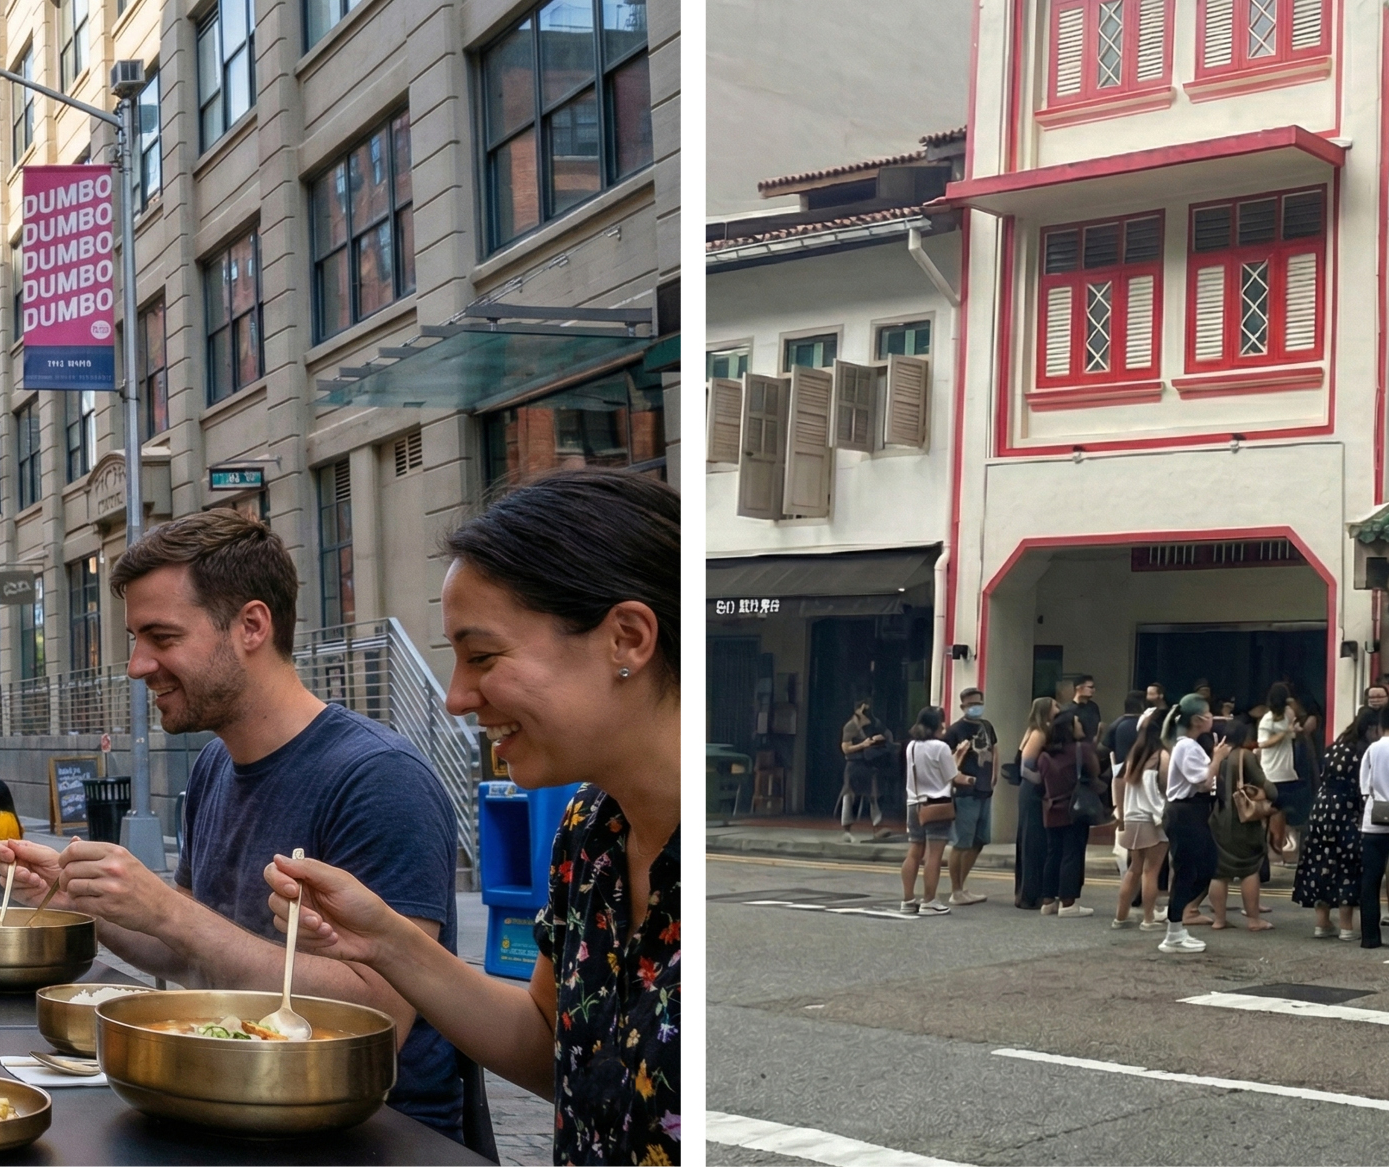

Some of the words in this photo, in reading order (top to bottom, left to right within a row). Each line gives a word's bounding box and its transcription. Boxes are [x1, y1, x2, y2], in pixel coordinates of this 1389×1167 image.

[23, 174, 112, 219] DUMBO
[23, 202, 112, 247] DUMBO
[23, 231, 112, 276] DUMBO
[23, 259, 113, 304] DUMBO
[23, 288, 113, 333] DUMBO
